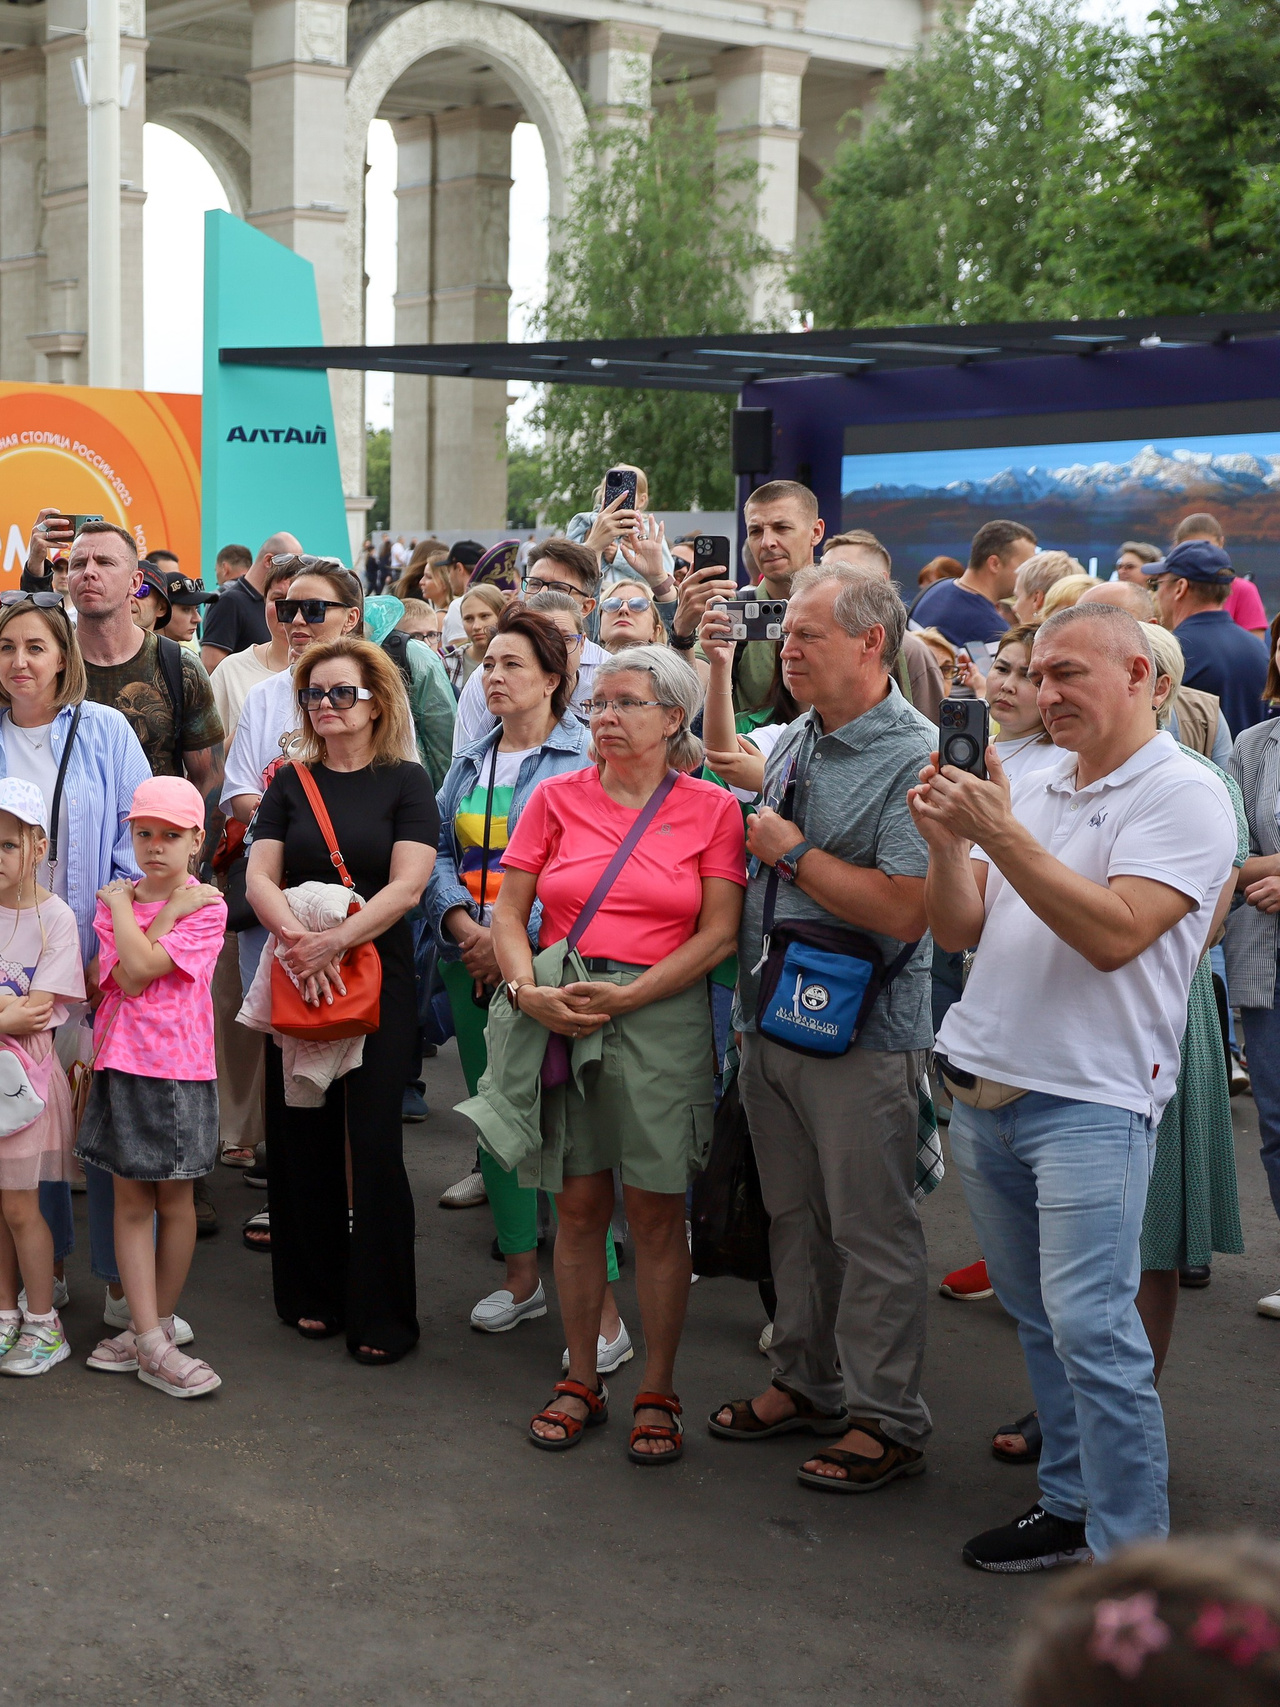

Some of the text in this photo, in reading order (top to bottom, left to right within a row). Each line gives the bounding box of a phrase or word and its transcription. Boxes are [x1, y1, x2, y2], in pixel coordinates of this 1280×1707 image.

[226, 424, 327, 444] АЛТАЙ
[20, 431, 71, 448] СТОЛИЦА
[71, 440, 134, 507] РОССИИ-2025
